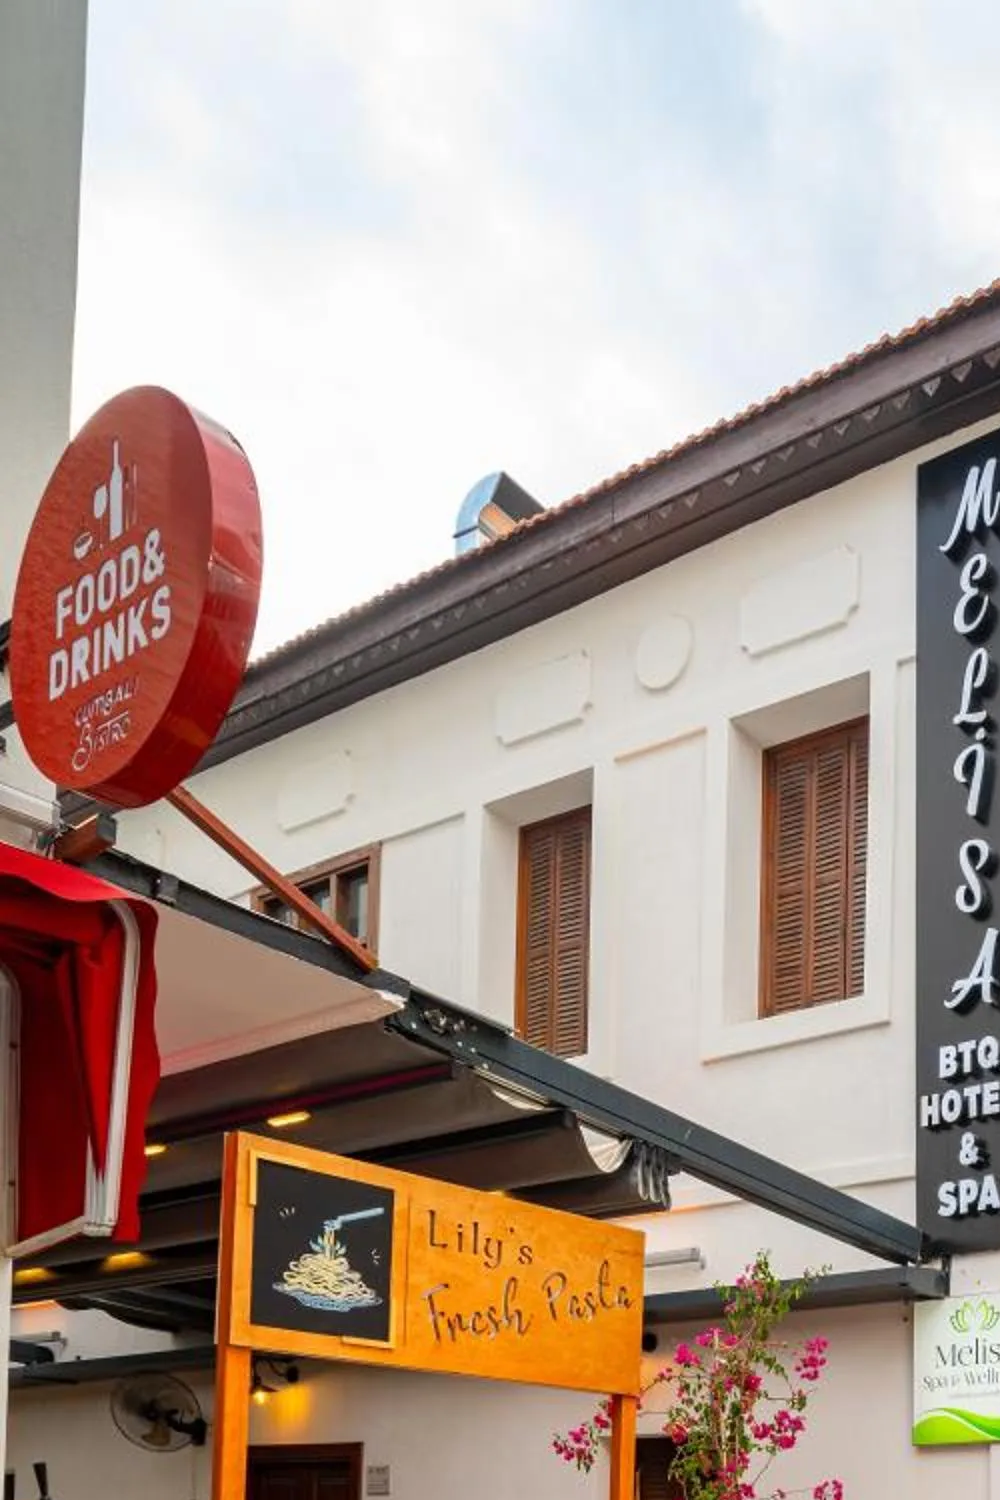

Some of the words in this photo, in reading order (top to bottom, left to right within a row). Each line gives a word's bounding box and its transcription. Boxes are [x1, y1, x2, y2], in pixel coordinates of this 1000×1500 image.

[55, 527, 166, 640] FOOD&
[48, 584, 172, 702] DRINKS
[938, 1036, 1000, 1079] BTQ
[959, 1132, 980, 1165] &
[427, 1209, 534, 1270] Lily's
[422, 1276, 532, 1344] Fresh
[541, 1259, 634, 1322] Pasta
[921, 1375, 948, 1392] Spa
